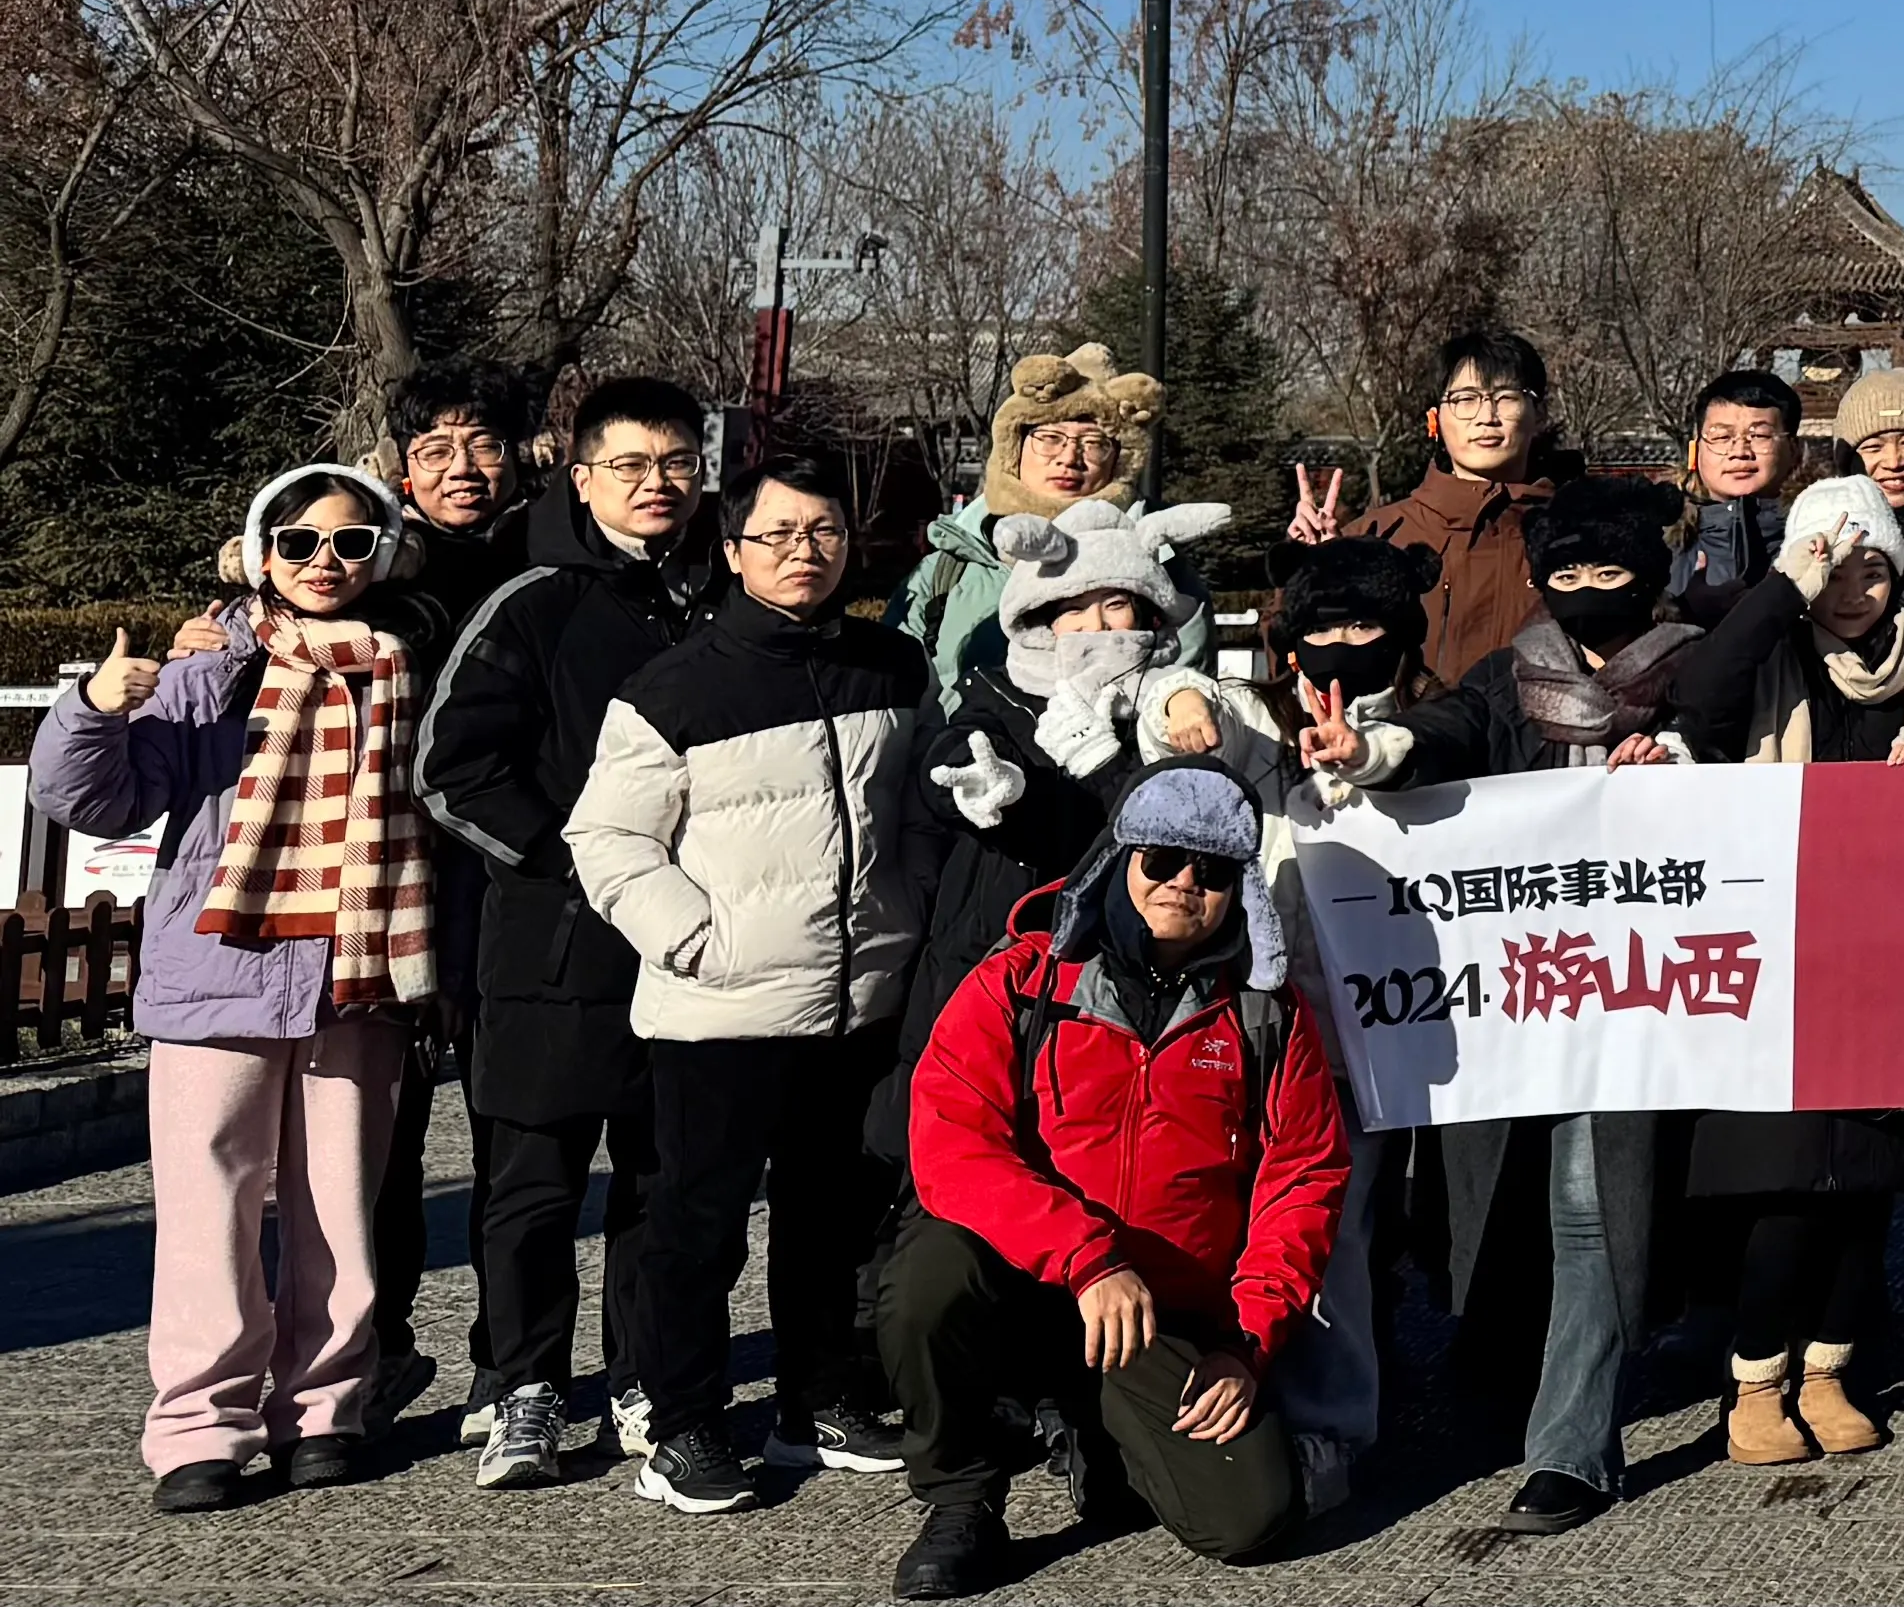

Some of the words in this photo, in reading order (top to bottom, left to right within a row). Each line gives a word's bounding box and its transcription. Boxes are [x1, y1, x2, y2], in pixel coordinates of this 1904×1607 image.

[1386, 857, 1707, 922] IQ国际事业部
